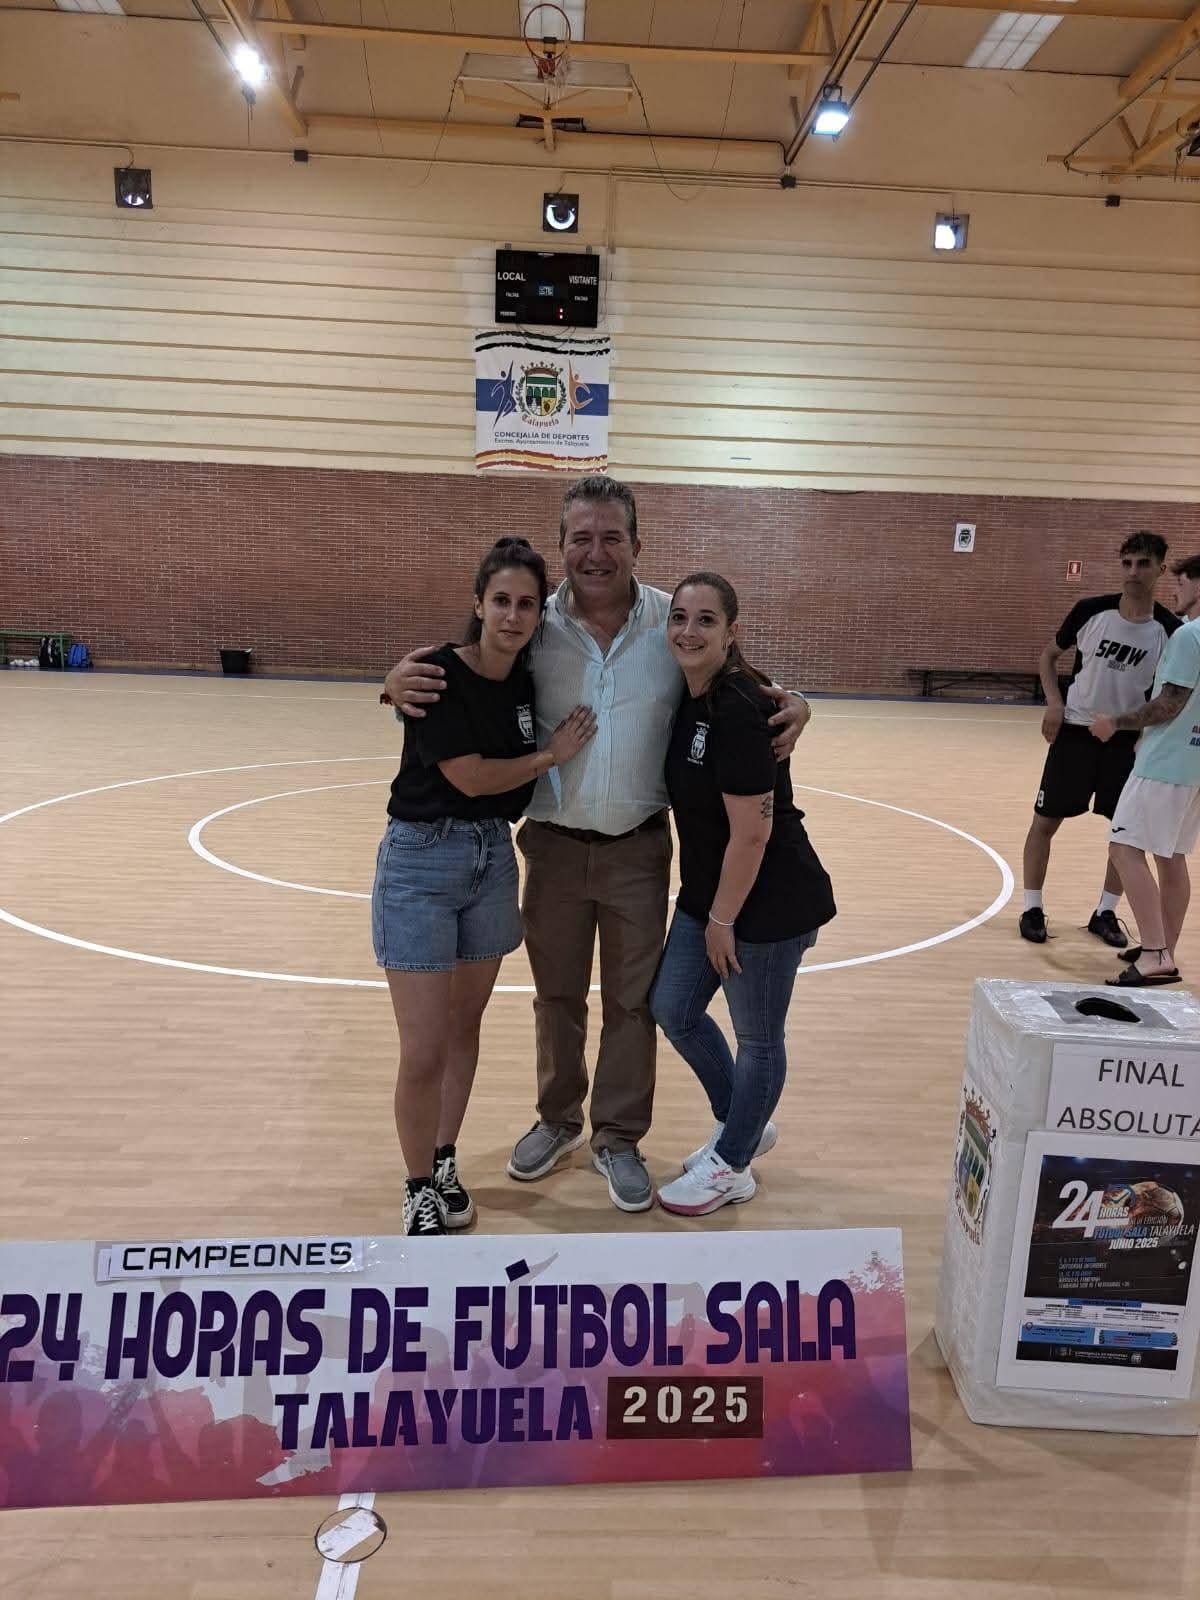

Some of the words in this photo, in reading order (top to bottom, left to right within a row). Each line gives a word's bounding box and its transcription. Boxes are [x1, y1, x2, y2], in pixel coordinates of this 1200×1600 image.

[497, 271, 526, 282] LOCAL
[568, 275, 598, 286] VISITANTE
[552, 433, 590, 441] DEPORTES
[1098, 1058, 1185, 1088] FINAL
[1052, 1180, 1104, 1238] 24
[1099, 1206, 1130, 1218] HORAS
[1149, 1224, 1195, 1237] TALAYUELA
[1109, 1239, 1134, 1250] JUNIO
[1135, 1237, 1159, 1249] 2025
[122, 1242, 353, 1271] CAMPEONES
[0, 1293, 83, 1383] 24
[104, 1288, 326, 1380] HORAS
[347, 1286, 429, 1375] DE
[453, 1258, 684, 1371] FÚTBOL
[706, 1279, 857, 1365] SALA
[274, 1385, 593, 1451] TALAYUELA
[622, 1385, 748, 1423] 2025
